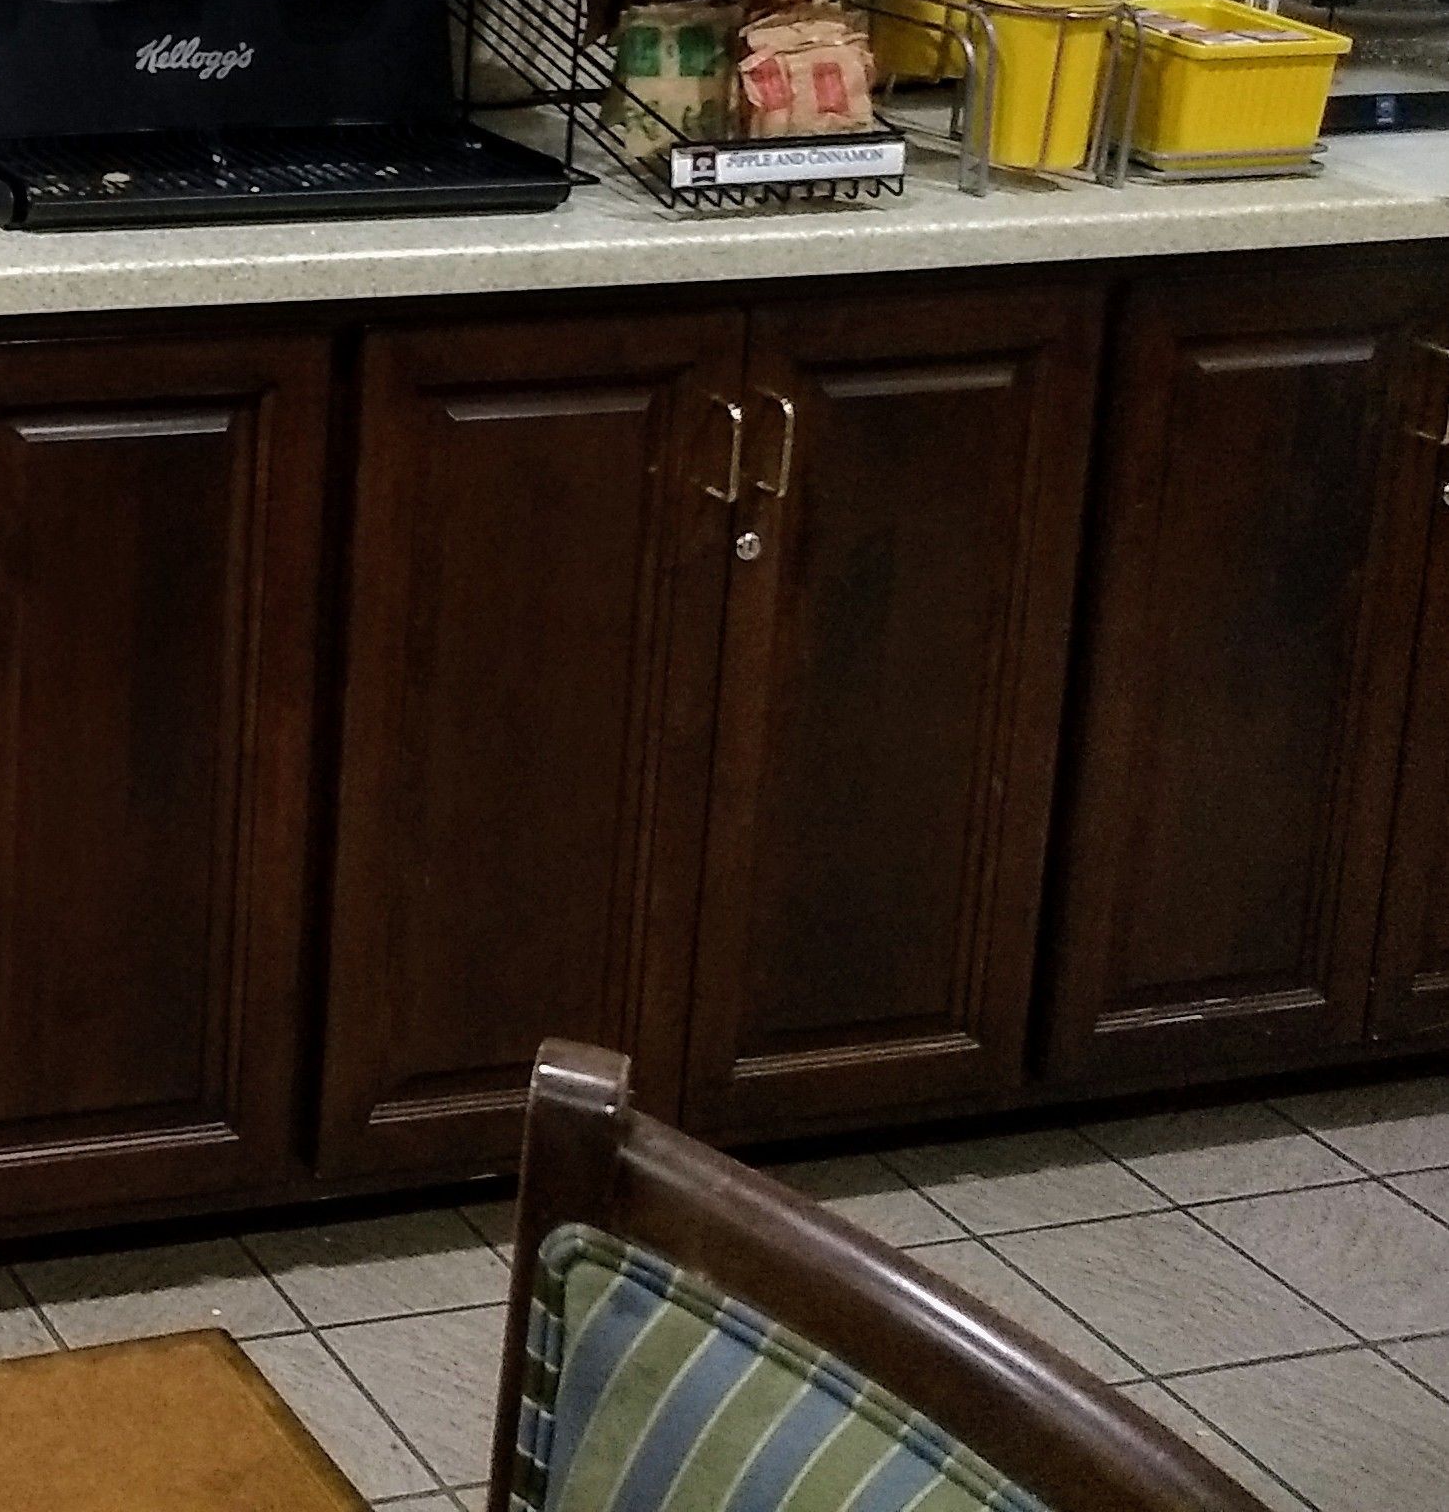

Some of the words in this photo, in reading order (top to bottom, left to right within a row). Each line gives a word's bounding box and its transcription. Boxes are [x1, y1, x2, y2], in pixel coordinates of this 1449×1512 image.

[135, 33, 255, 80] Kellogg's
[775, 151, 806, 166] AND
[808, 148, 885, 165] CINNAMON
